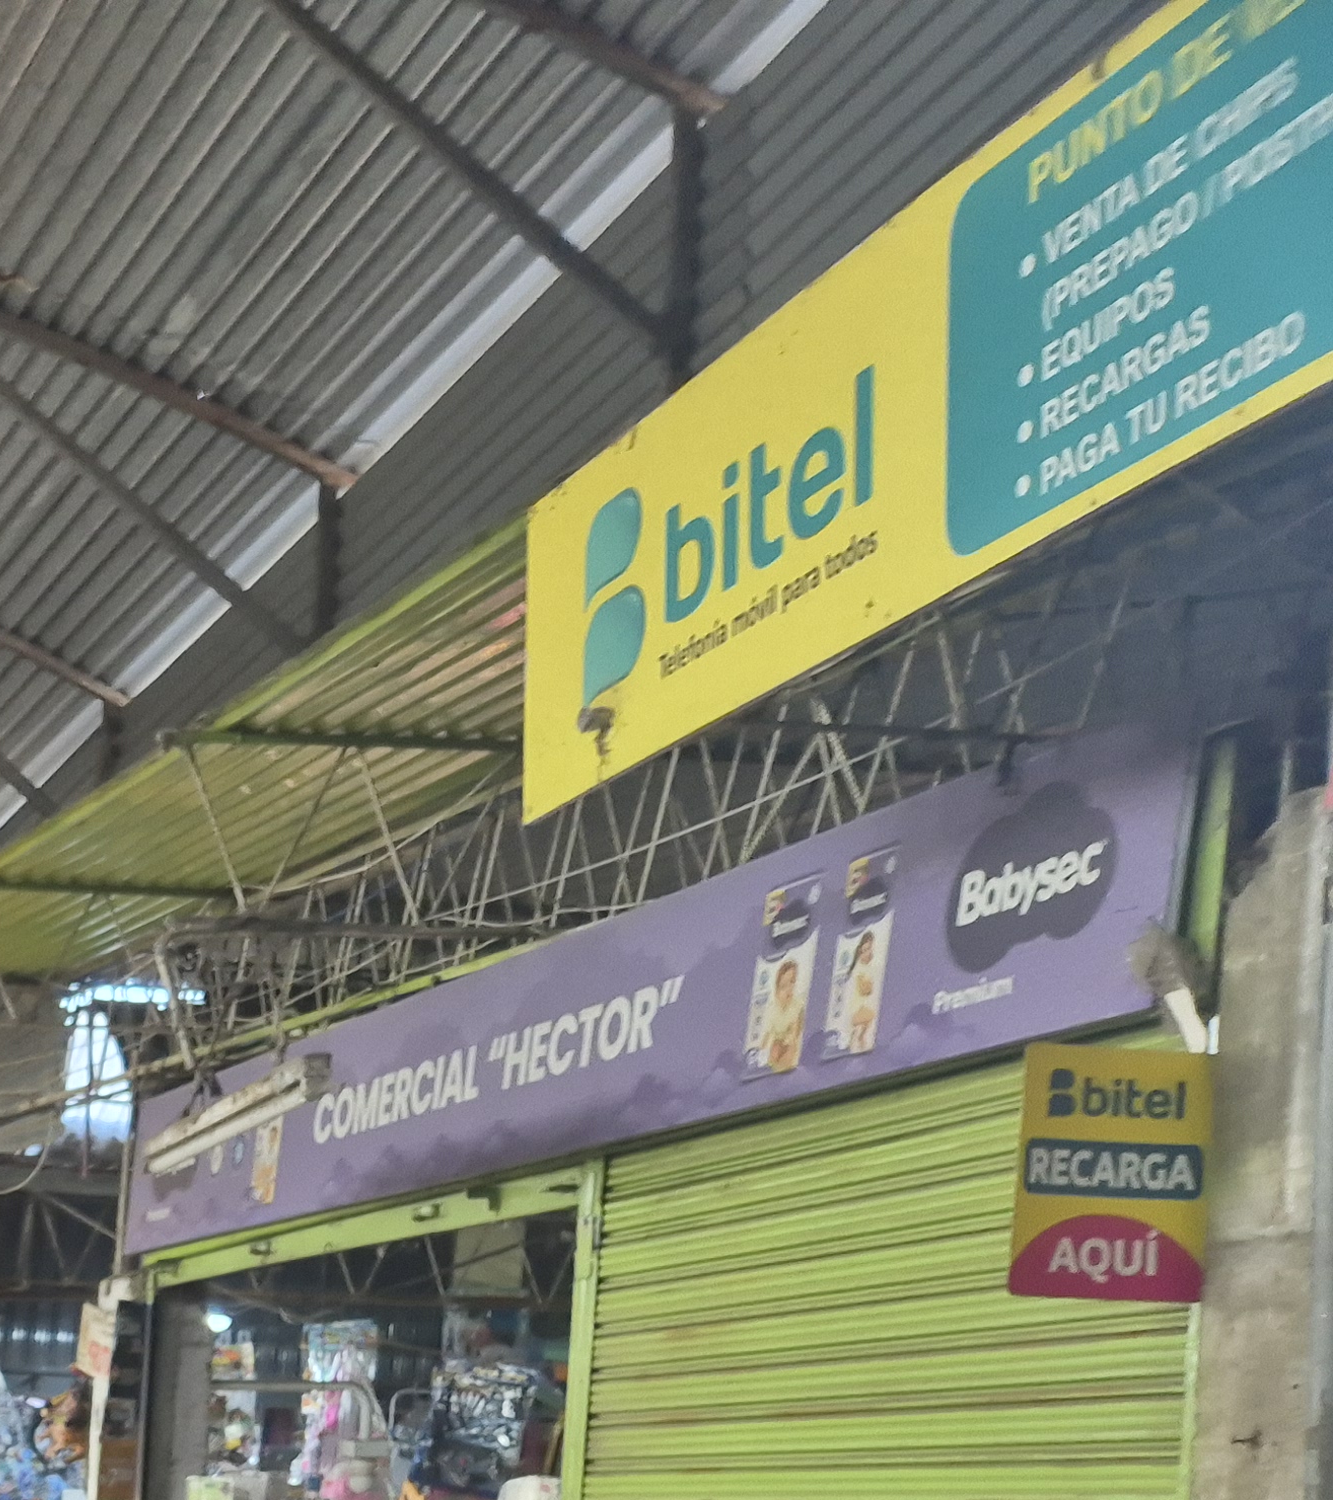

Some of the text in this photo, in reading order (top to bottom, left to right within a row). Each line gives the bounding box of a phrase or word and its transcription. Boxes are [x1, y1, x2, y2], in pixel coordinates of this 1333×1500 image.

[1028, 12, 1233, 203] PUNTO DE
[1042, 173, 1140, 264] VENTA
[1143, 134, 1190, 197] DE
[1042, 191, 1199, 331] (PREPAGO
[1039, 303, 1211, 439] RECARGAS
[1040, 267, 1175, 382] EQUIPOS
[1039, 310, 1306, 496] PAGA TU RECIBO
[664, 363, 876, 623] bitel
[781, 565, 821, 615] para
[824, 529, 879, 580] todos
[955, 841, 1105, 927] Babysec
[313, 1045, 479, 1144] COMERCIAL
[1083, 1077, 1187, 1120] bitel
[1027, 1148, 1197, 1191] RECARGA
[1048, 1229, 1160, 1284] AQUÍ
